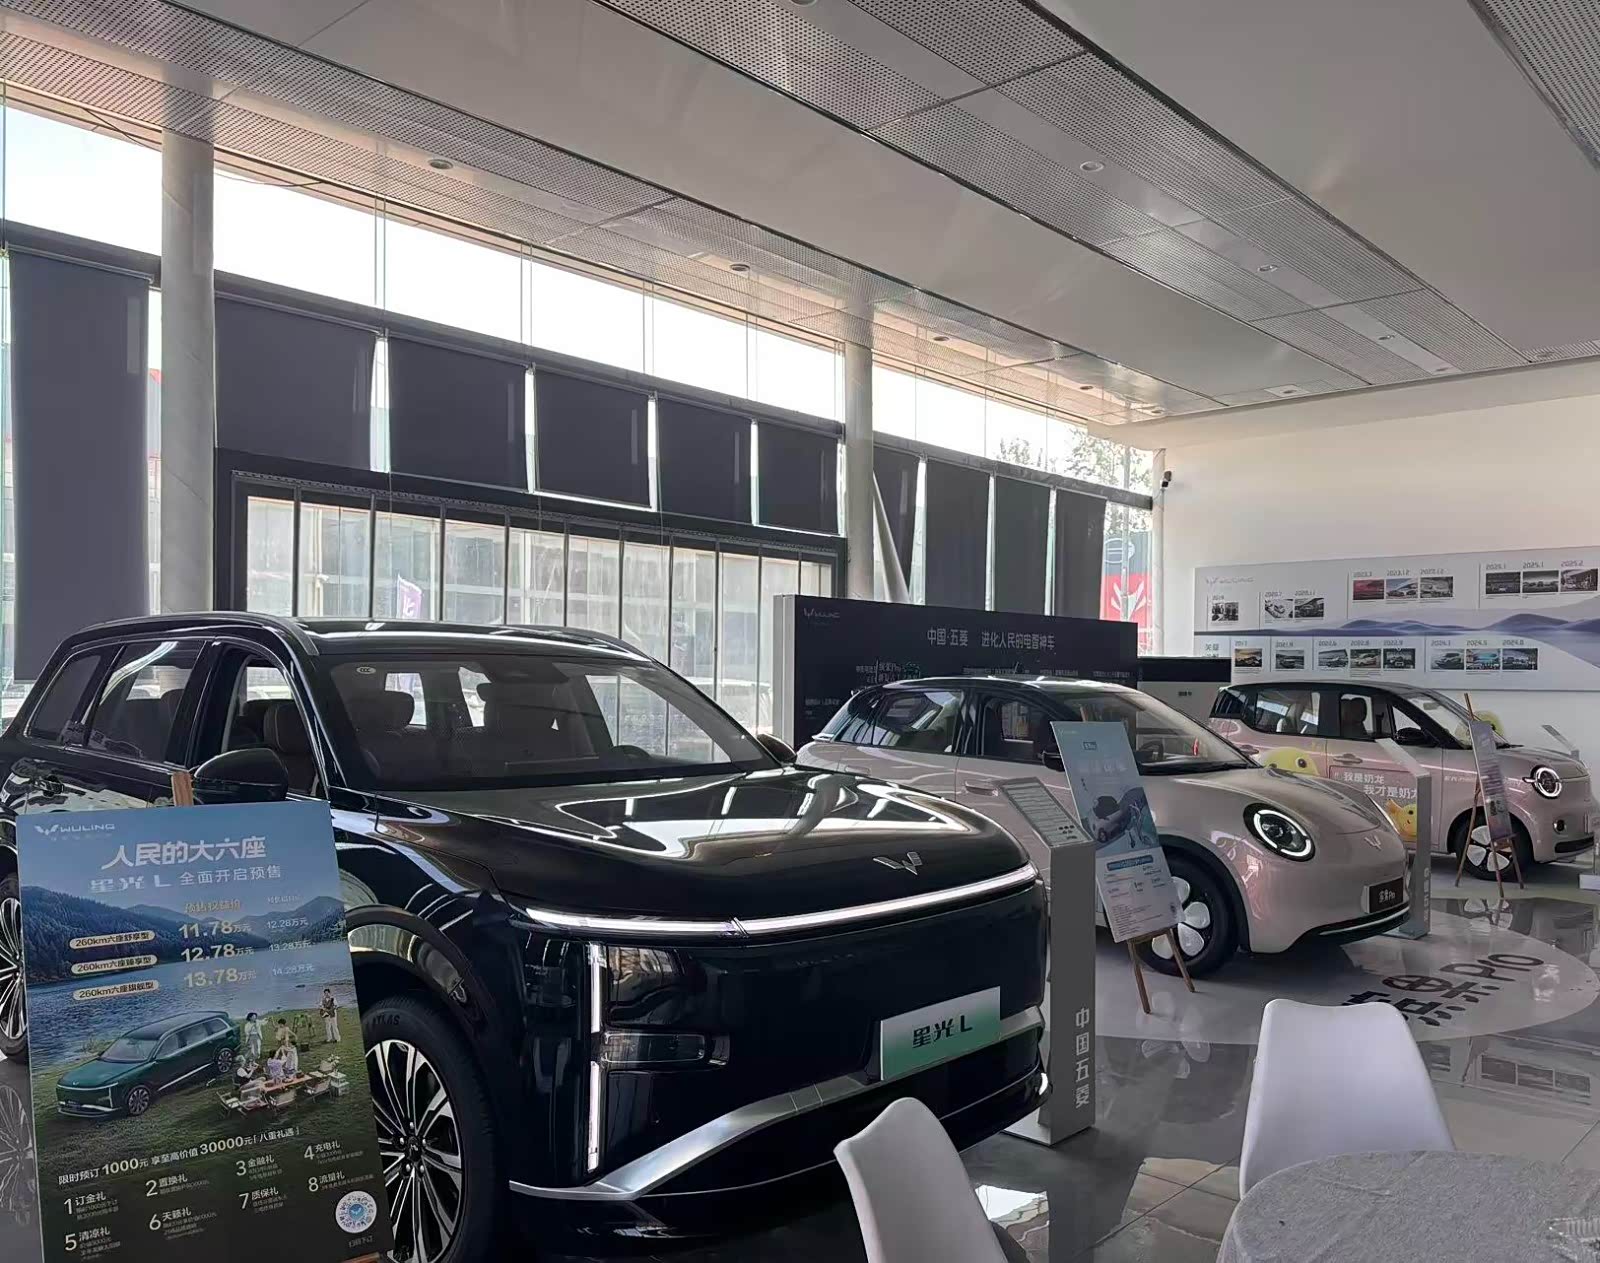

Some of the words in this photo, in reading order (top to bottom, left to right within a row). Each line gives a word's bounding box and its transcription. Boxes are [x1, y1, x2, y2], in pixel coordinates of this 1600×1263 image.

[101, 836, 266, 870] 人民的大六座
[180, 864, 281, 886] 全面开启预售
[178, 921, 252, 939] 11.78万元
[181, 943, 254, 963] 12.78万元
[184, 968, 257, 988] 13.78万元
[1075, 1007, 1090, 1109] 中国五菱
[304, 1145, 315, 1160] 4
[236, 1160, 247, 1176] 3
[146, 1180, 158, 1197] 2
[308, 1176, 318, 1192] 8
[64, 1198, 72, 1214] 1
[75, 1191, 106, 1206] 订金礼
[238, 1192, 250, 1210] 7
[251, 1186, 279, 1200] 质保礼
[149, 1214, 162, 1230] 6
[65, 1233, 78, 1251] 5
